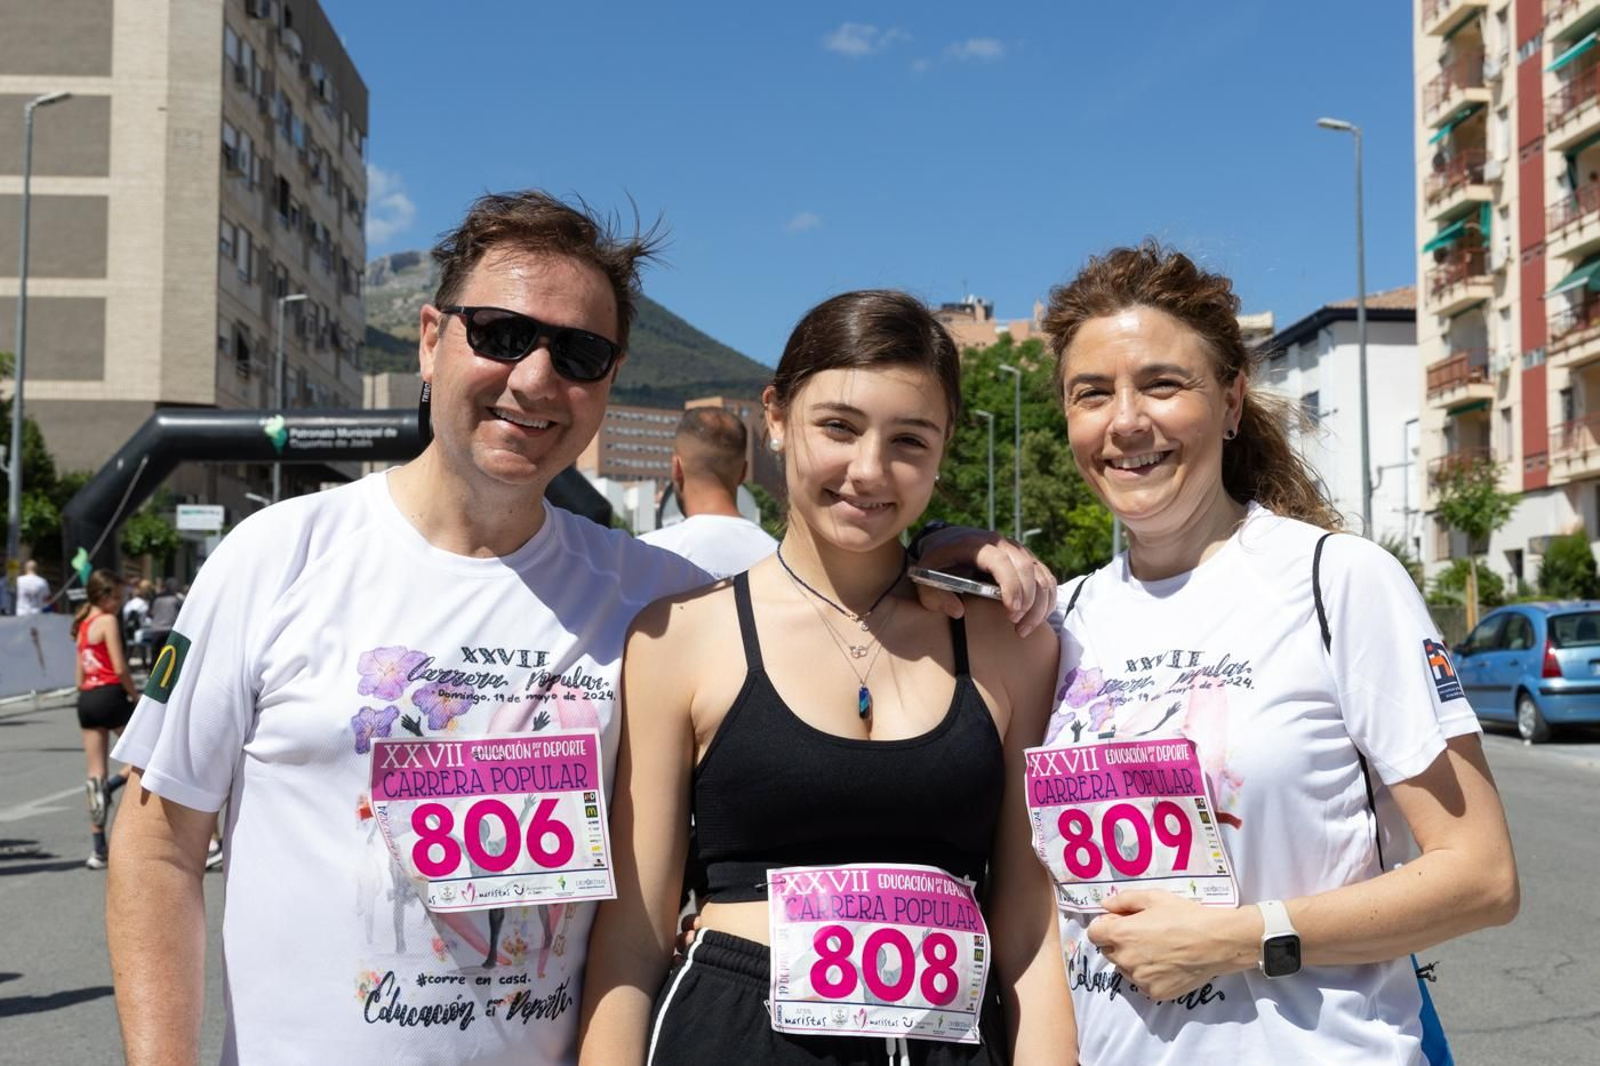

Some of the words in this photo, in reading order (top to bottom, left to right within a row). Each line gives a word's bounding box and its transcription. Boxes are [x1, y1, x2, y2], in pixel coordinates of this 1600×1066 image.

[461, 646, 550, 669] XXVII
[1125, 650, 1205, 672] XXVII
[493, 693, 504, 702] 19
[507, 694, 521, 703] de
[526, 693, 558, 704] mayo
[563, 691, 577, 701] de
[381, 743, 465, 769] XXVII
[472, 741, 532, 761] EDUCACIÓN
[543, 740, 586, 758] DEPORTE
[1031, 748, 1099, 777] XXVII
[1156, 744, 1189, 762] DEPORTE
[383, 769, 485, 798] CARRERA
[492, 763, 588, 793] POPULAR
[1034, 772, 1119, 804] CARRERA
[1123, 768, 1196, 797] POPULAR
[411, 799, 574, 878] 806
[1058, 801, 1193, 879] 809
[782, 870, 869, 896] XXVII
[878, 873, 935, 893] EDUCACIÓN
[785, 896, 887, 922] CARRERA
[894, 896, 978, 931] POPULAR
[416, 972, 466, 987] #corre
[475, 976, 491, 986] en
[810, 925, 959, 1006] 808
[785, 1016, 827, 1028] maristas
